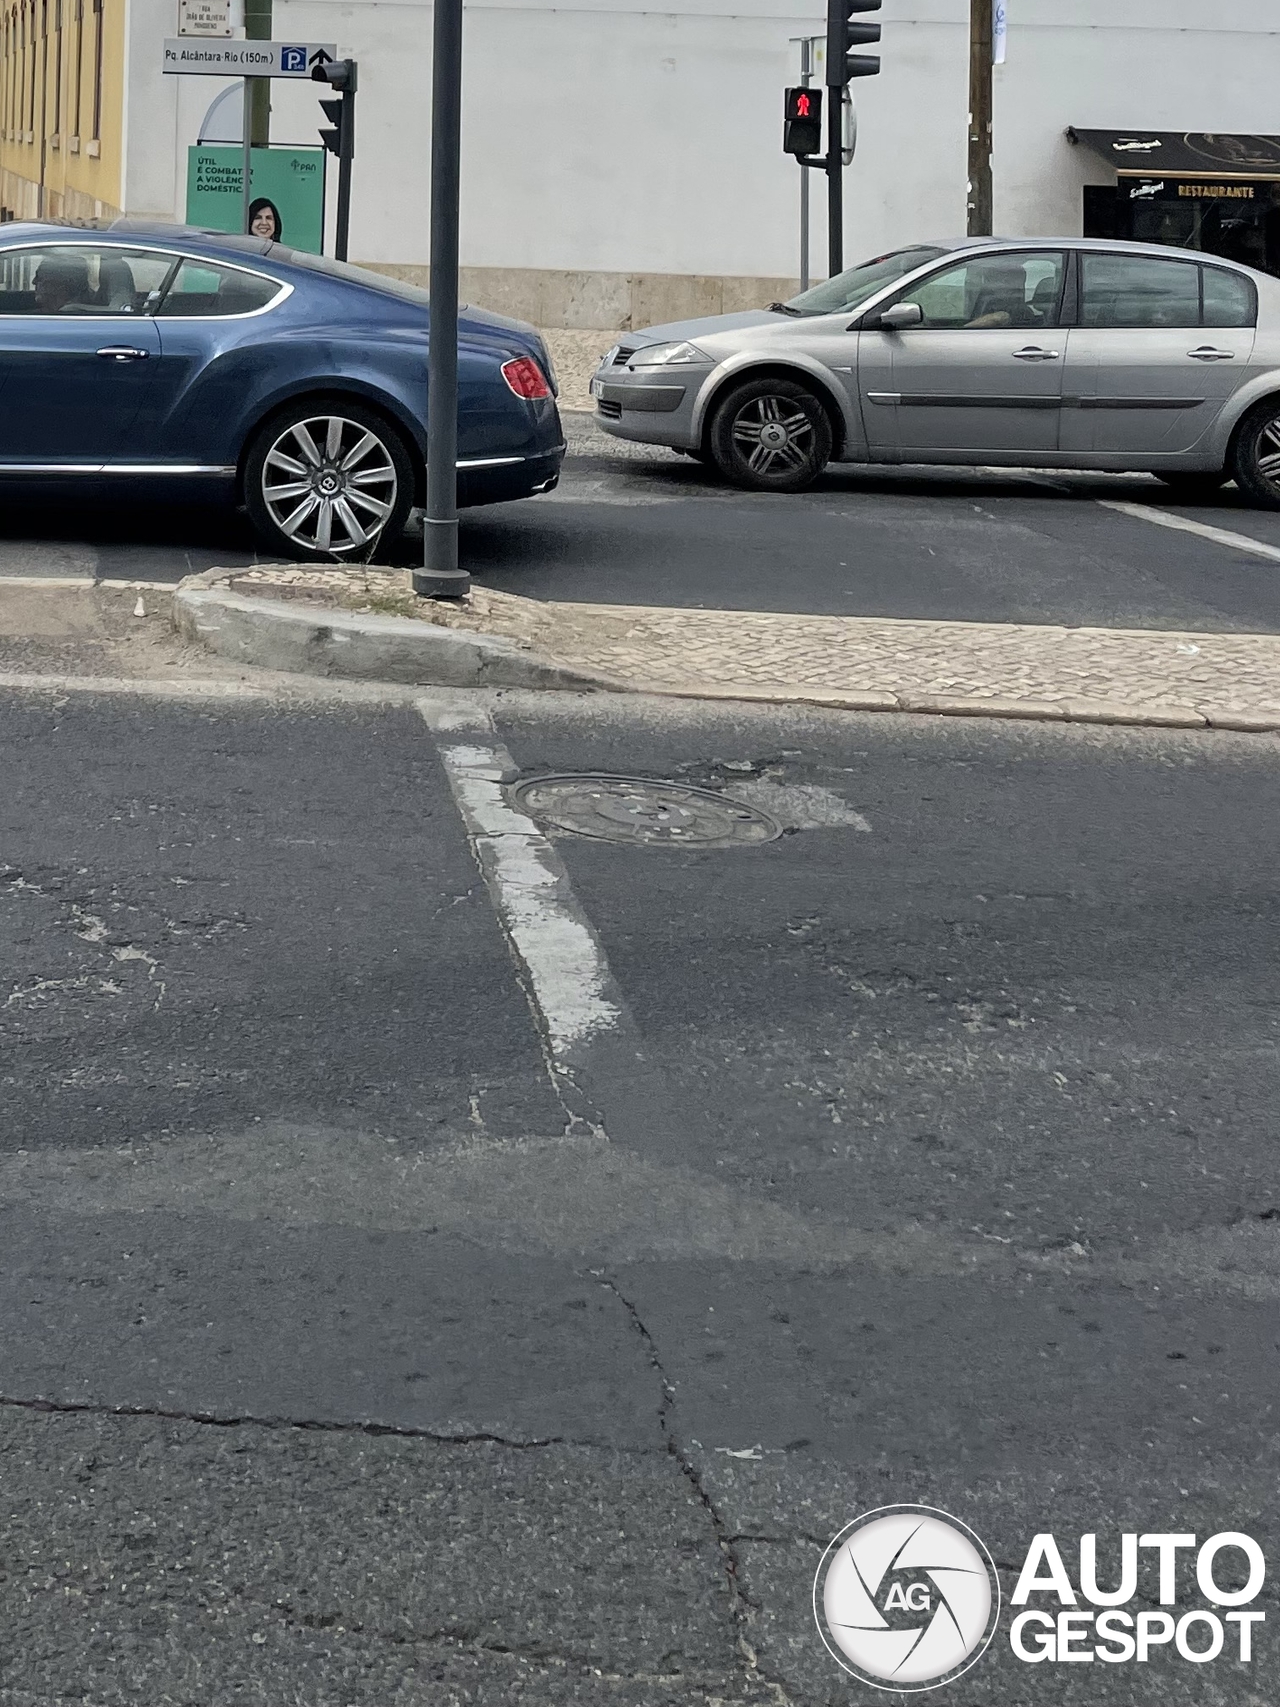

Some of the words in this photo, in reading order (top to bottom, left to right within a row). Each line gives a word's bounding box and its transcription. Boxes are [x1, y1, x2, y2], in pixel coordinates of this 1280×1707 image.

[165, 50, 178, 61] Pq.
[180, 51, 238, 63] Alcântara-Rio
[240, 52, 274, 64] (150m)
[197, 156, 217, 165] ÚTIL
[197, 165, 203, 174] É
[205, 167, 254, 175] COMBATR
[196, 175, 204, 183] A
[197, 184, 244, 193] DOMÉSTIC
[1178, 185, 1254, 198] RESTAURANTE
